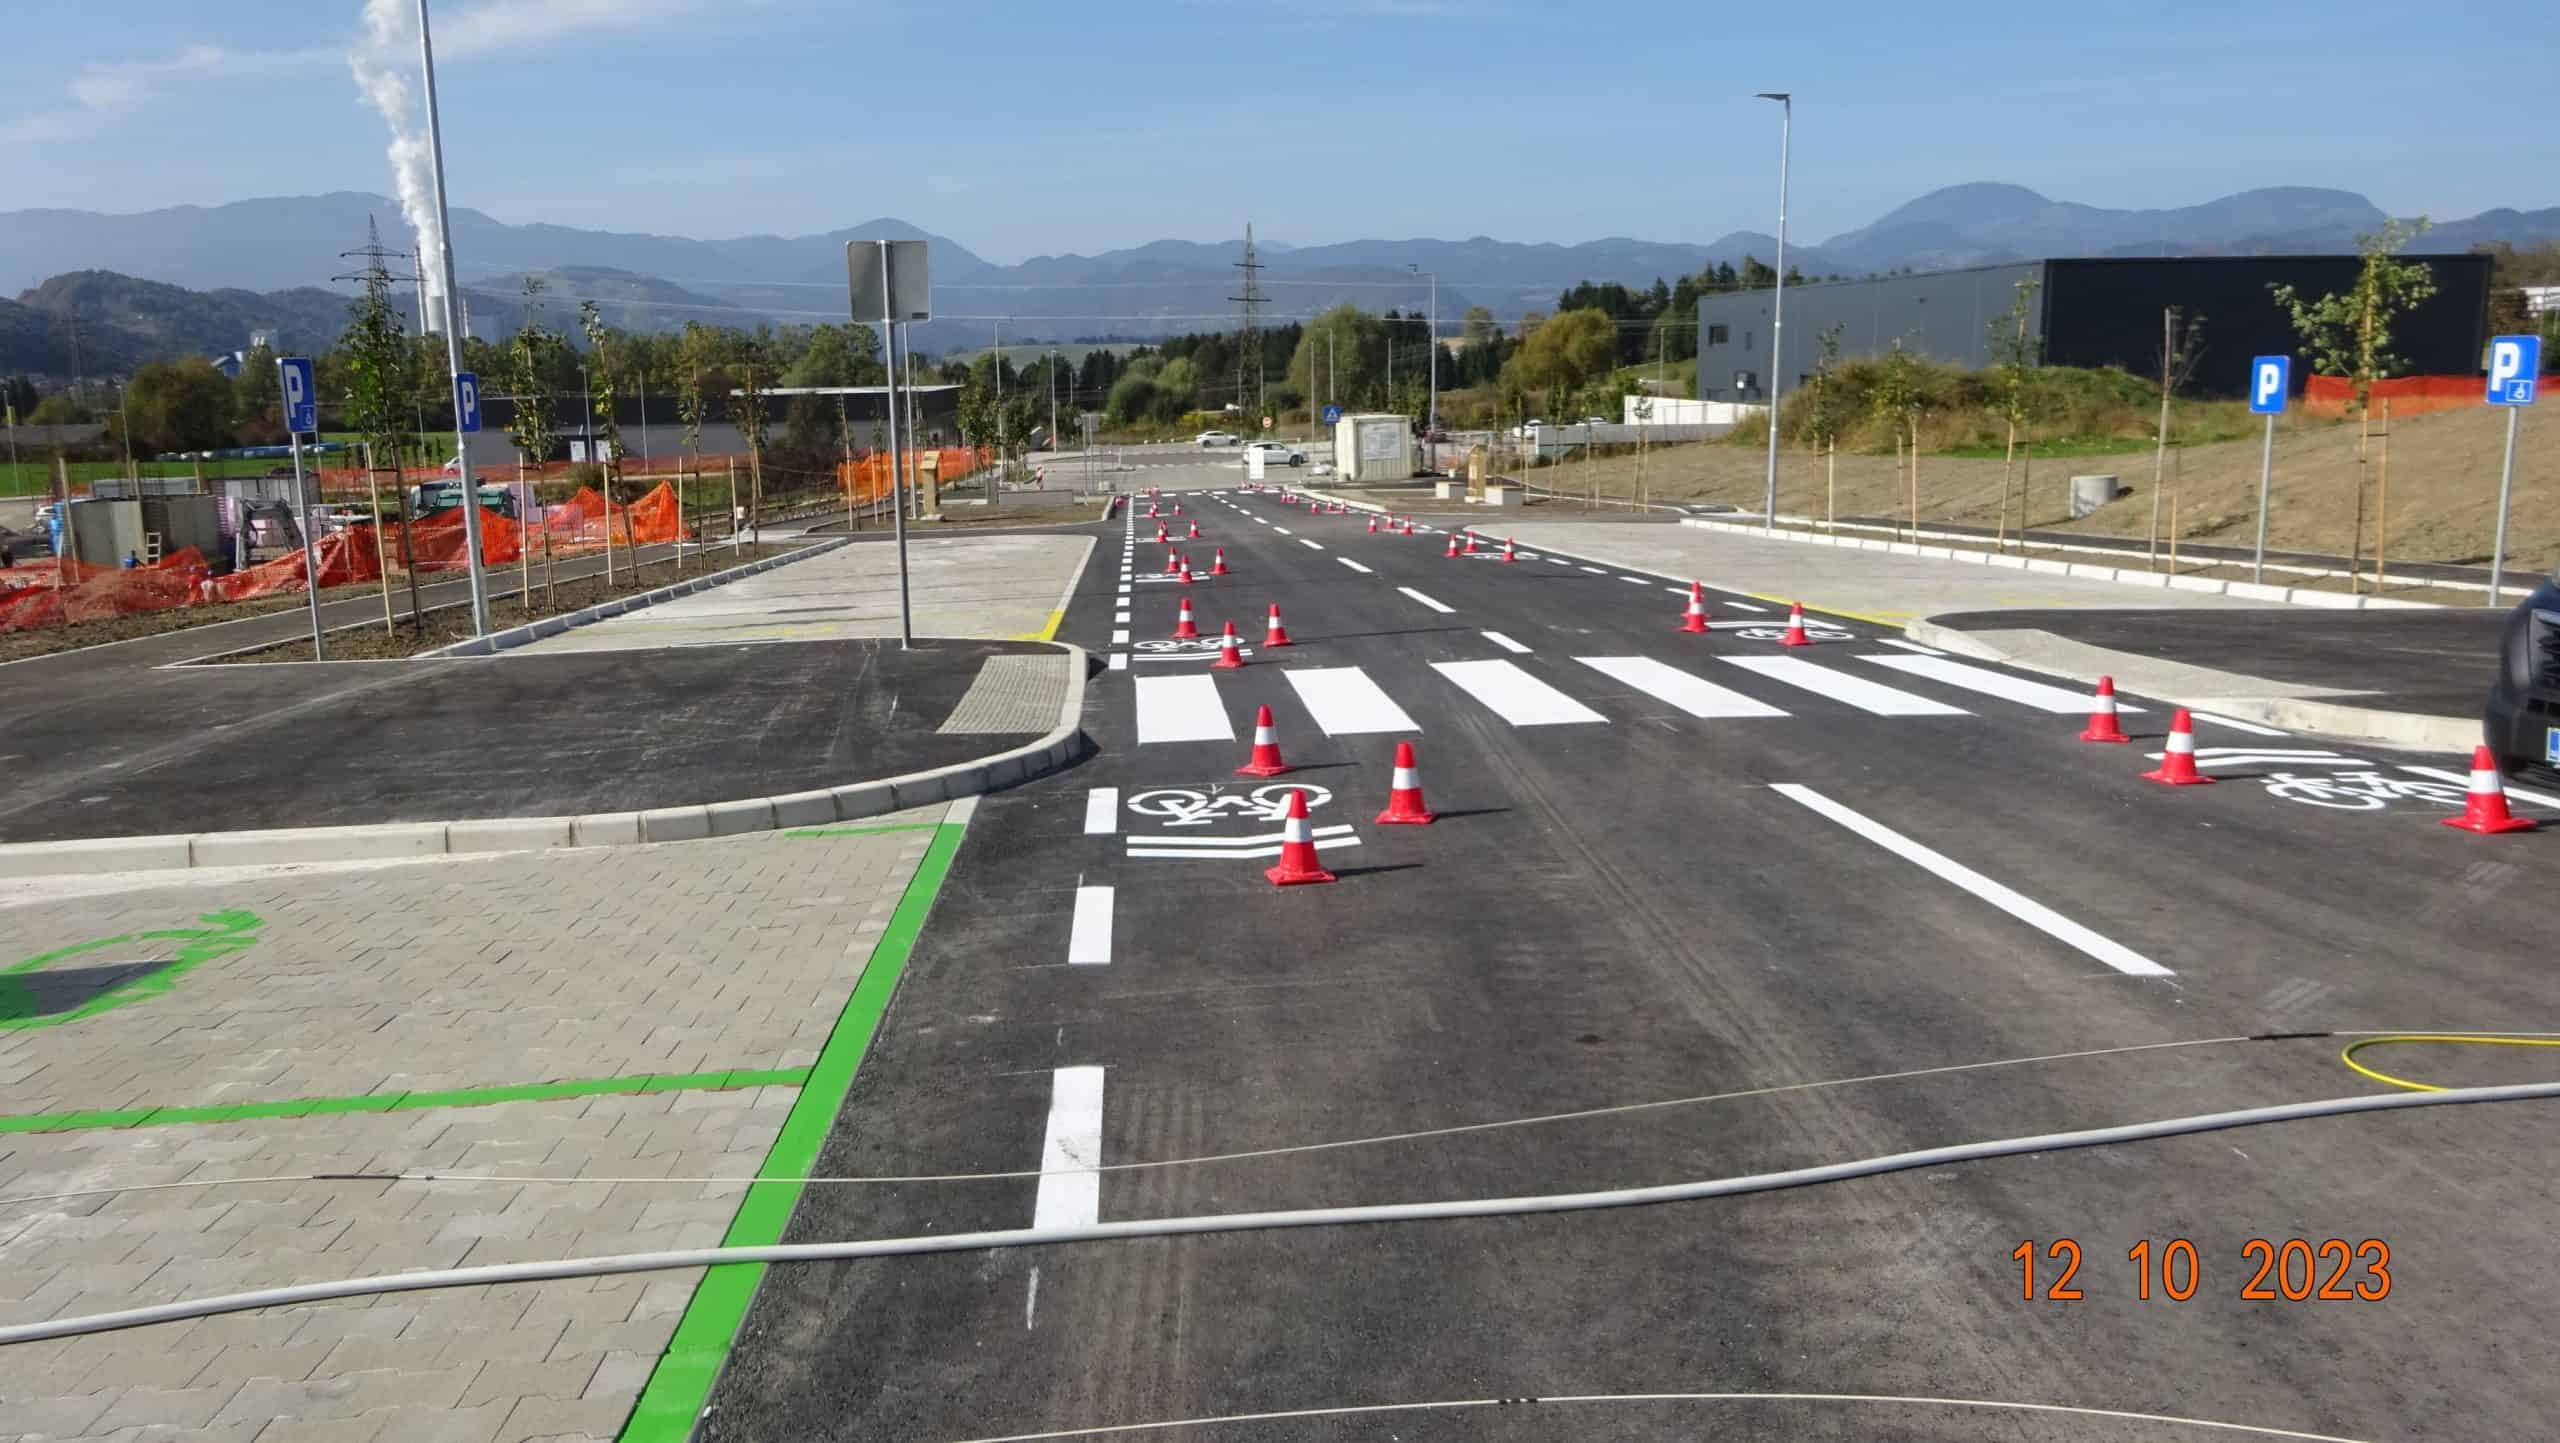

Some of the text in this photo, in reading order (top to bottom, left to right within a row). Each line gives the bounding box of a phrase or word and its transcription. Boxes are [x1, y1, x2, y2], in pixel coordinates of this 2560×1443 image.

[2258, 364, 2280, 405] P
[2491, 342, 2520, 392] P
[283, 364, 303, 418] P
[461, 382, 475, 425] P
